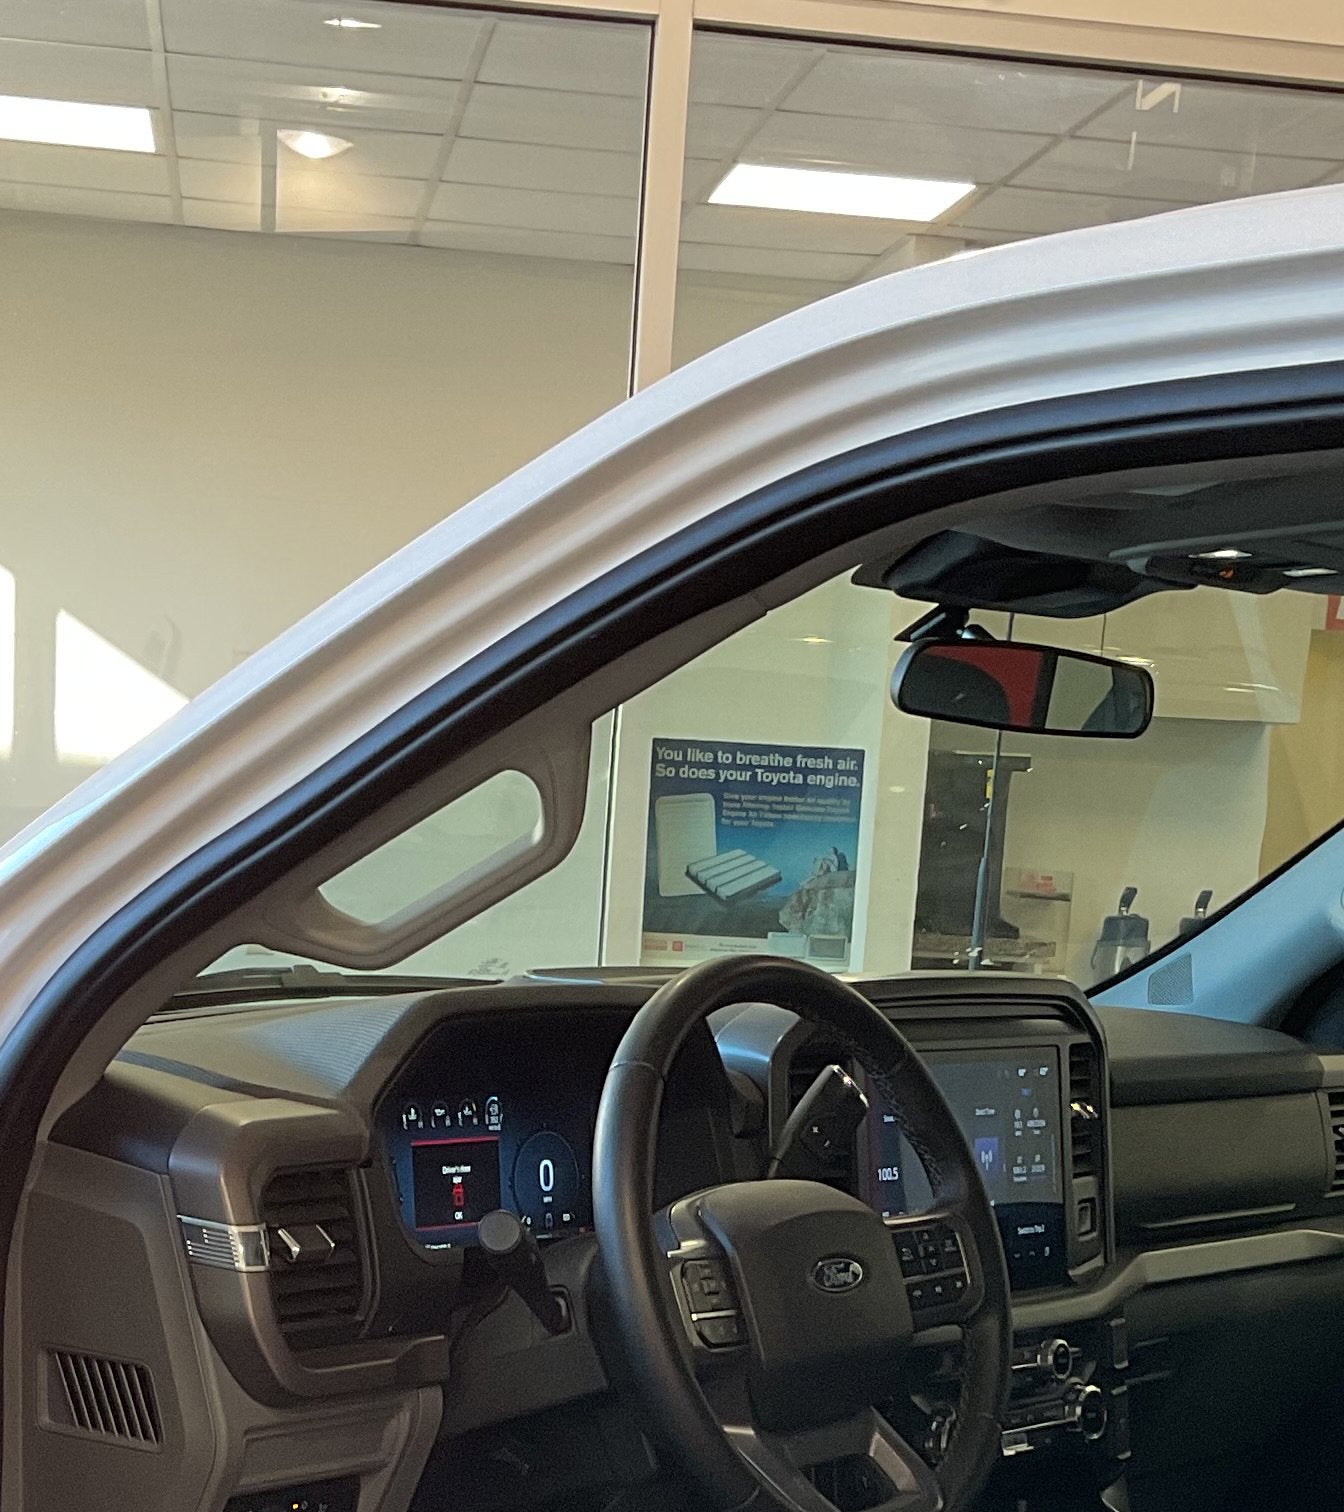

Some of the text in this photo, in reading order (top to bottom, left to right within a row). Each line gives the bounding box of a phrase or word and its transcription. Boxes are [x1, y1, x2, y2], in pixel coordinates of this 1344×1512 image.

[655, 746, 859, 771] You like to breathe fresh air.
[655, 763, 860, 788] So does your Toyota engine.
[539, 1159, 554, 1192] 0
[877, 1166, 899, 1181] 100.5
